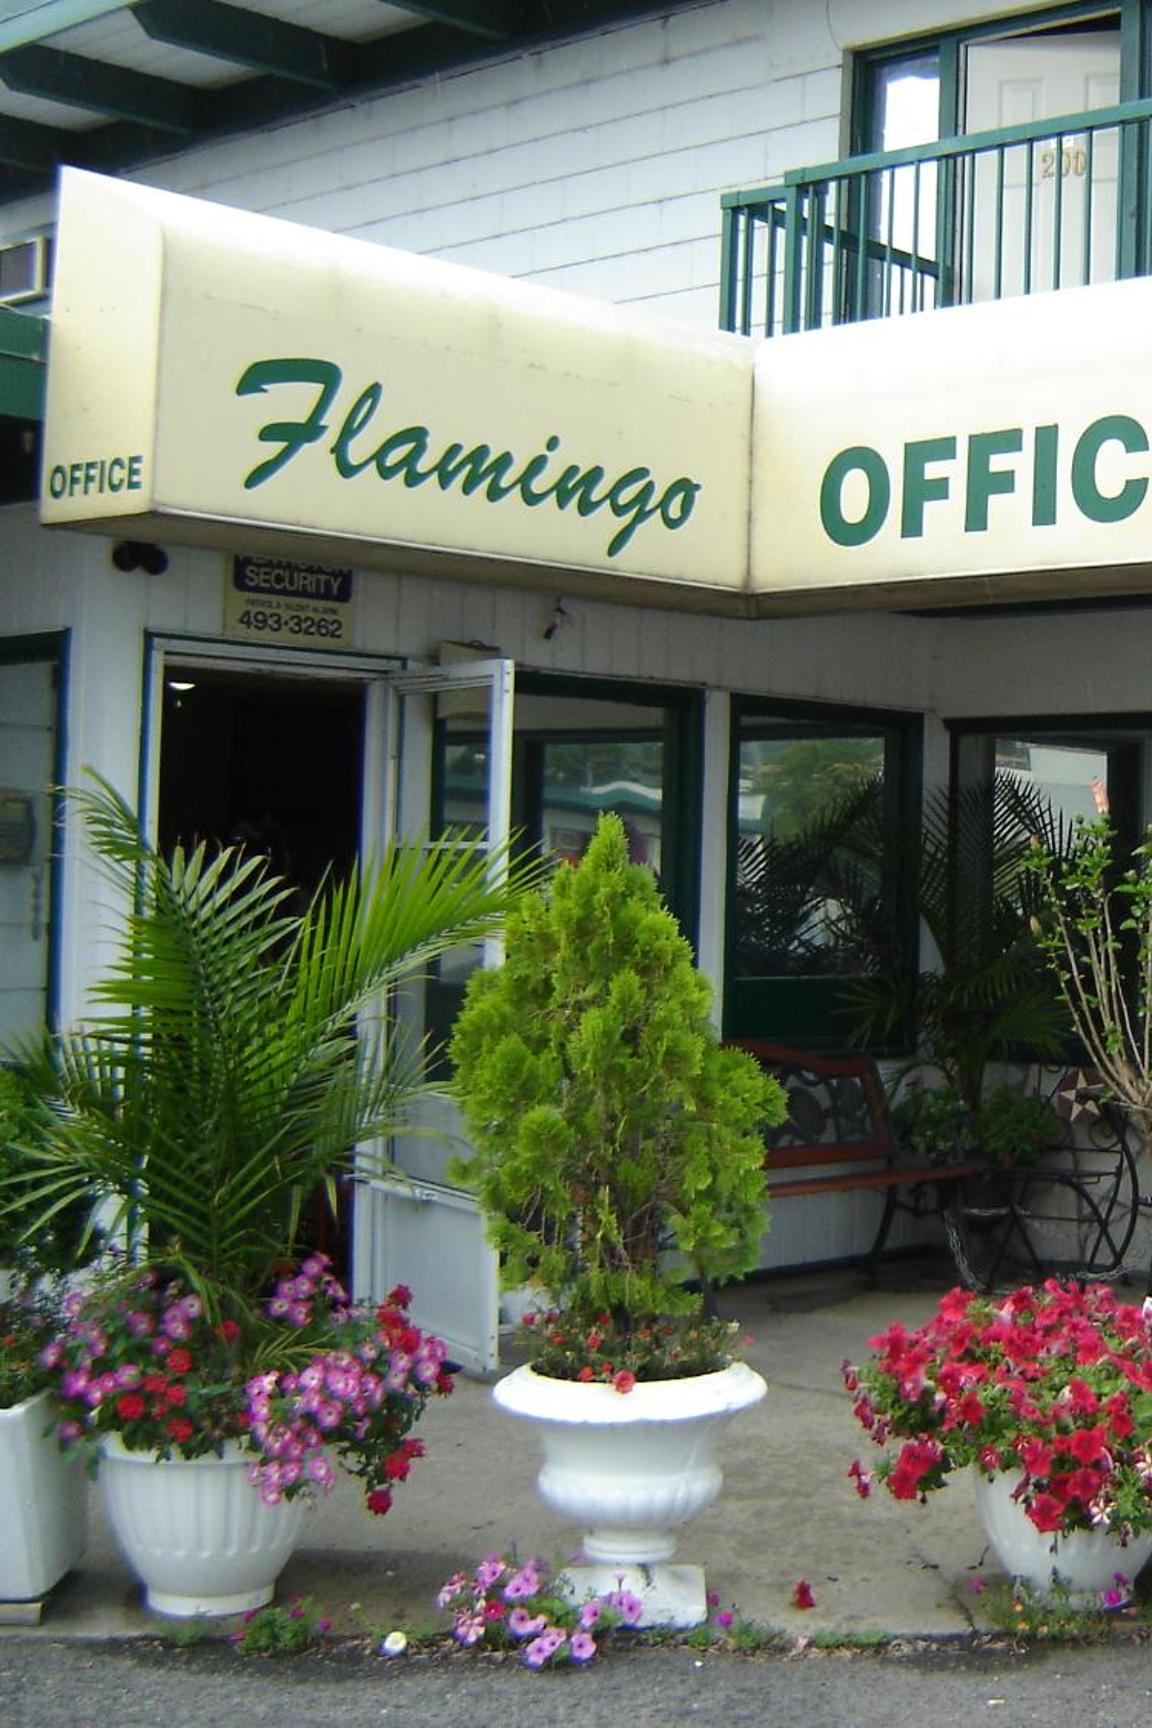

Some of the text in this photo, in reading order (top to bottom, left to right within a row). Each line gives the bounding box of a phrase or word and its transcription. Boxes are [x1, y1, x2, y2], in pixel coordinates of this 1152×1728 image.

[50, 455, 143, 499] OFFICE
[236, 358, 702, 557] Flamingo
[245, 565, 343, 596] SECURITY
